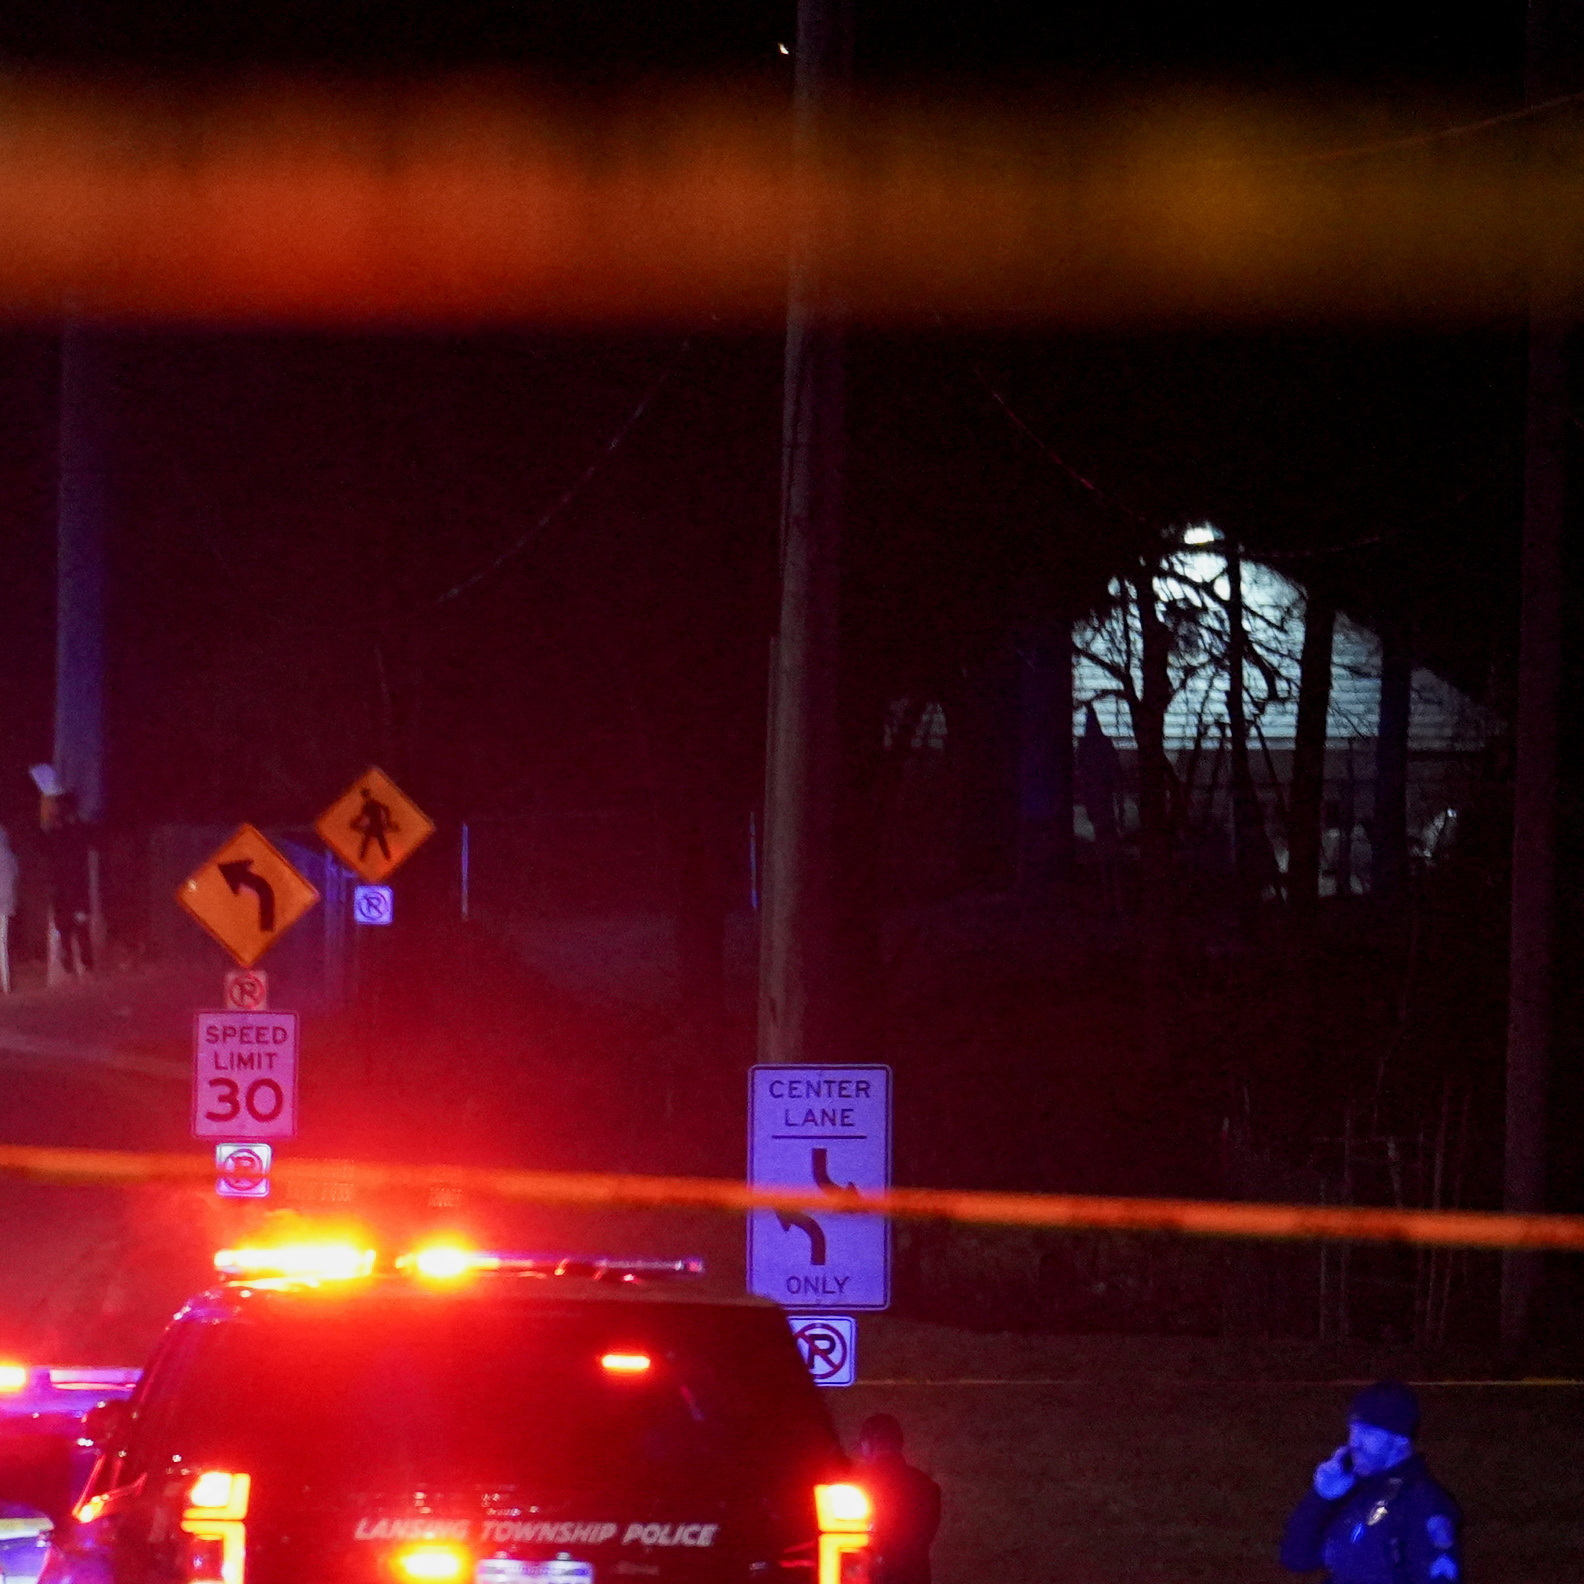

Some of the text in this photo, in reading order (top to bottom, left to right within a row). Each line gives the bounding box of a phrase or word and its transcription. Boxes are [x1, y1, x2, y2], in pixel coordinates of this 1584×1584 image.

[205, 1025, 288, 1044] SPEED
[214, 1053, 277, 1070] LIMIT
[769, 1080, 871, 1099] CENTER
[205, 1077, 284, 1123] 30
[785, 1109, 854, 1126] LANE
[787, 1275, 850, 1294] ONLY
[482, 1520, 618, 1545] TOWNSHIP
[622, 1522, 720, 1548] POLICE
